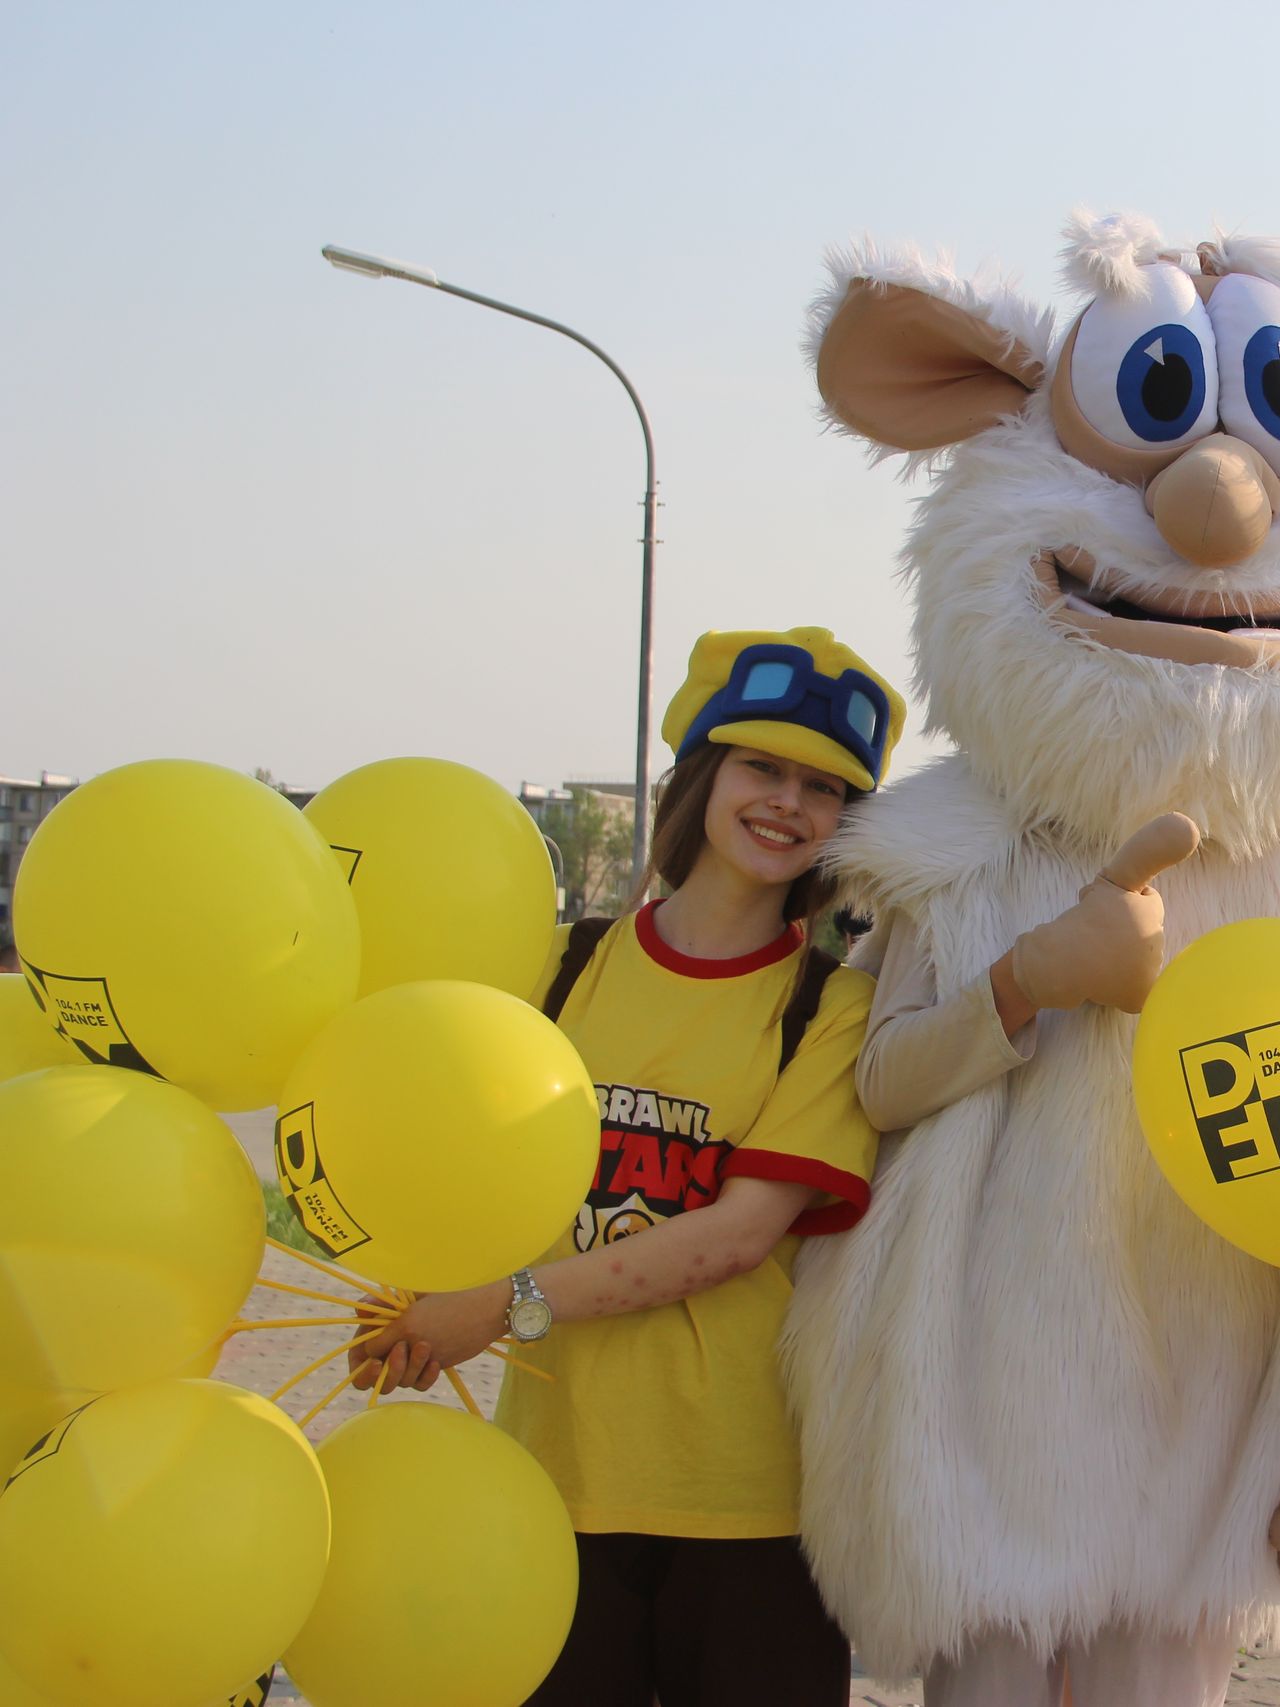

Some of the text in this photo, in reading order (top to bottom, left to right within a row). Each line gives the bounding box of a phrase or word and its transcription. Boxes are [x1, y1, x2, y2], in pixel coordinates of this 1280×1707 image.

[55, 998, 102, 1013] 104.1 FM
[60, 1011, 109, 1027] DANCE
[591, 1130, 722, 1213] TARS
[304, 1195, 342, 1243] DANCE
[332, 1222, 349, 1240] FM
